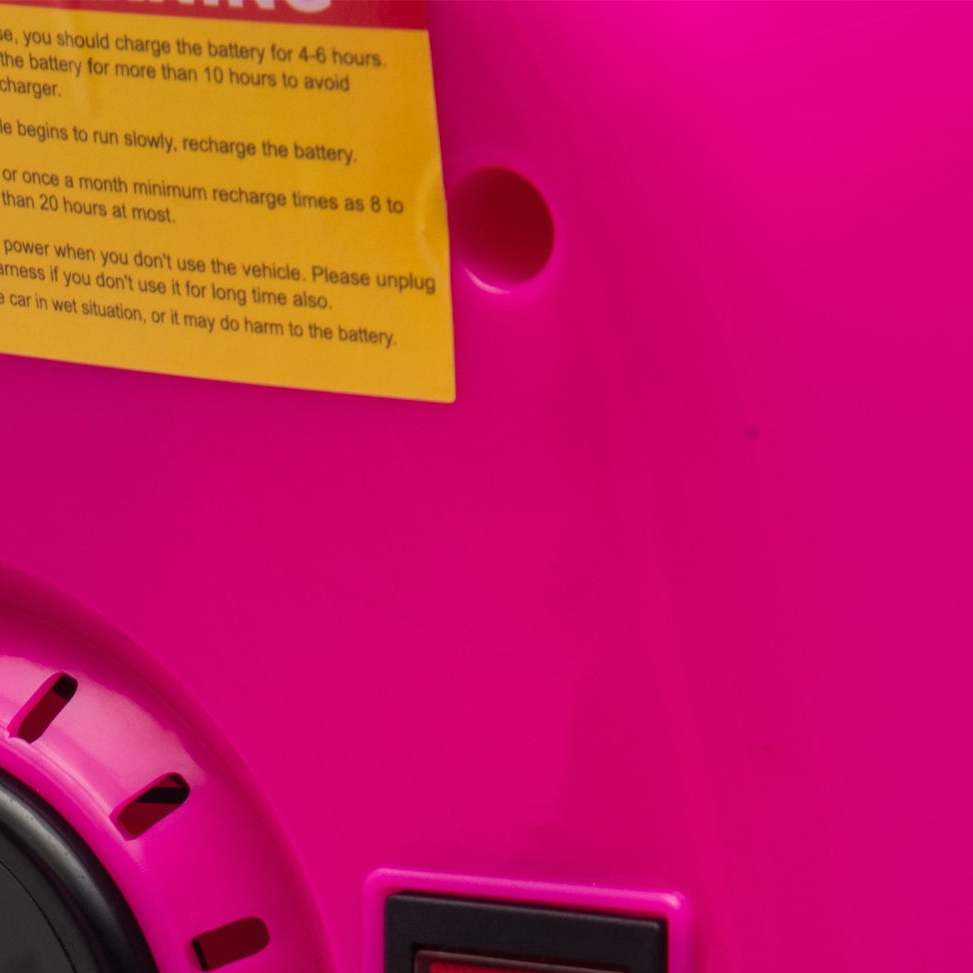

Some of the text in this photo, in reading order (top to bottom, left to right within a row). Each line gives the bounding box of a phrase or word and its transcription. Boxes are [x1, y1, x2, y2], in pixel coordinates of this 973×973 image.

[23, 29, 52, 47] you
[57, 29, 109, 49] should
[115, 34, 171, 58] charge
[176, 38, 202, 56] the
[207, 40, 265, 65] battery
[270, 44, 293, 61] for
[298, 47, 326, 64] 4-6
[332, 49, 386, 67] hours.
[0, 50, 24, 67] the
[29, 52, 82, 76] battery
[87, 57, 109, 75] for
[114, 64, 156, 80] more
[162, 64, 197, 82] than
[203, 67, 223, 83] 10
[229, 68, 277, 87] hours
[282, 72, 298, 89] to
[304, 75, 350, 92] avoid
[0, 76, 61, 99] charger.
[17, 119, 68, 142] begins
[73, 125, 88, 142] to
[93, 129, 119, 145] run
[124, 129, 178, 152] slowly,
[182, 135, 256, 159] recharge
[262, 139, 288, 157] the
[294, 142, 356, 165] battery.
[1, 191, 34, 209] than
[39, 194, 58, 211] 20
[63, 196, 107, 217] hours
[112, 203, 127, 219] at
[132, 206, 176, 224] most.
[2, 168, 17, 181] or
[22, 170, 59, 187] once
[65, 174, 74, 187] a
[79, 175, 127, 193] month
[133, 179, 207, 200] minimum
[213, 186, 286, 210] recharge
[292, 191, 338, 210] times
[344, 197, 364, 211] as
[370, 197, 380, 212] 8
[386, 198, 404, 214] to
[4, 238, 49, 256] power
[54, 240, 96, 262] when
[101, 248, 128, 266] you
[133, 249, 173, 271] don't
[177, 260, 206, 272] use
[211, 259, 237, 275] the
[242, 263, 306, 282] vehicle.
[312, 266, 370, 286] Please
[376, 271, 435, 294] unplug
[50, 266, 59, 283] if
[64, 270, 91, 287] you
[96, 271, 134, 291] don't
[138, 280, 167, 294] use
[172, 280, 181, 296] it
[185, 280, 205, 298] for
[211, 284, 247, 306] long
[251, 286, 287, 305] time
[293, 291, 333, 310] also.
[10, 292, 30, 307] car
[36, 292, 48, 310] in
[52, 297, 77, 313] wet
[82, 300, 146, 323] situation,
[151, 309, 166, 324] or
[170, 309, 180, 325] it
[184, 313, 215, 332] may
[221, 315, 239, 331] do
[244, 316, 284, 336] harm
[289, 322, 303, 338] to
[309, 324, 333, 340] the
[339, 326, 397, 348] battery.
